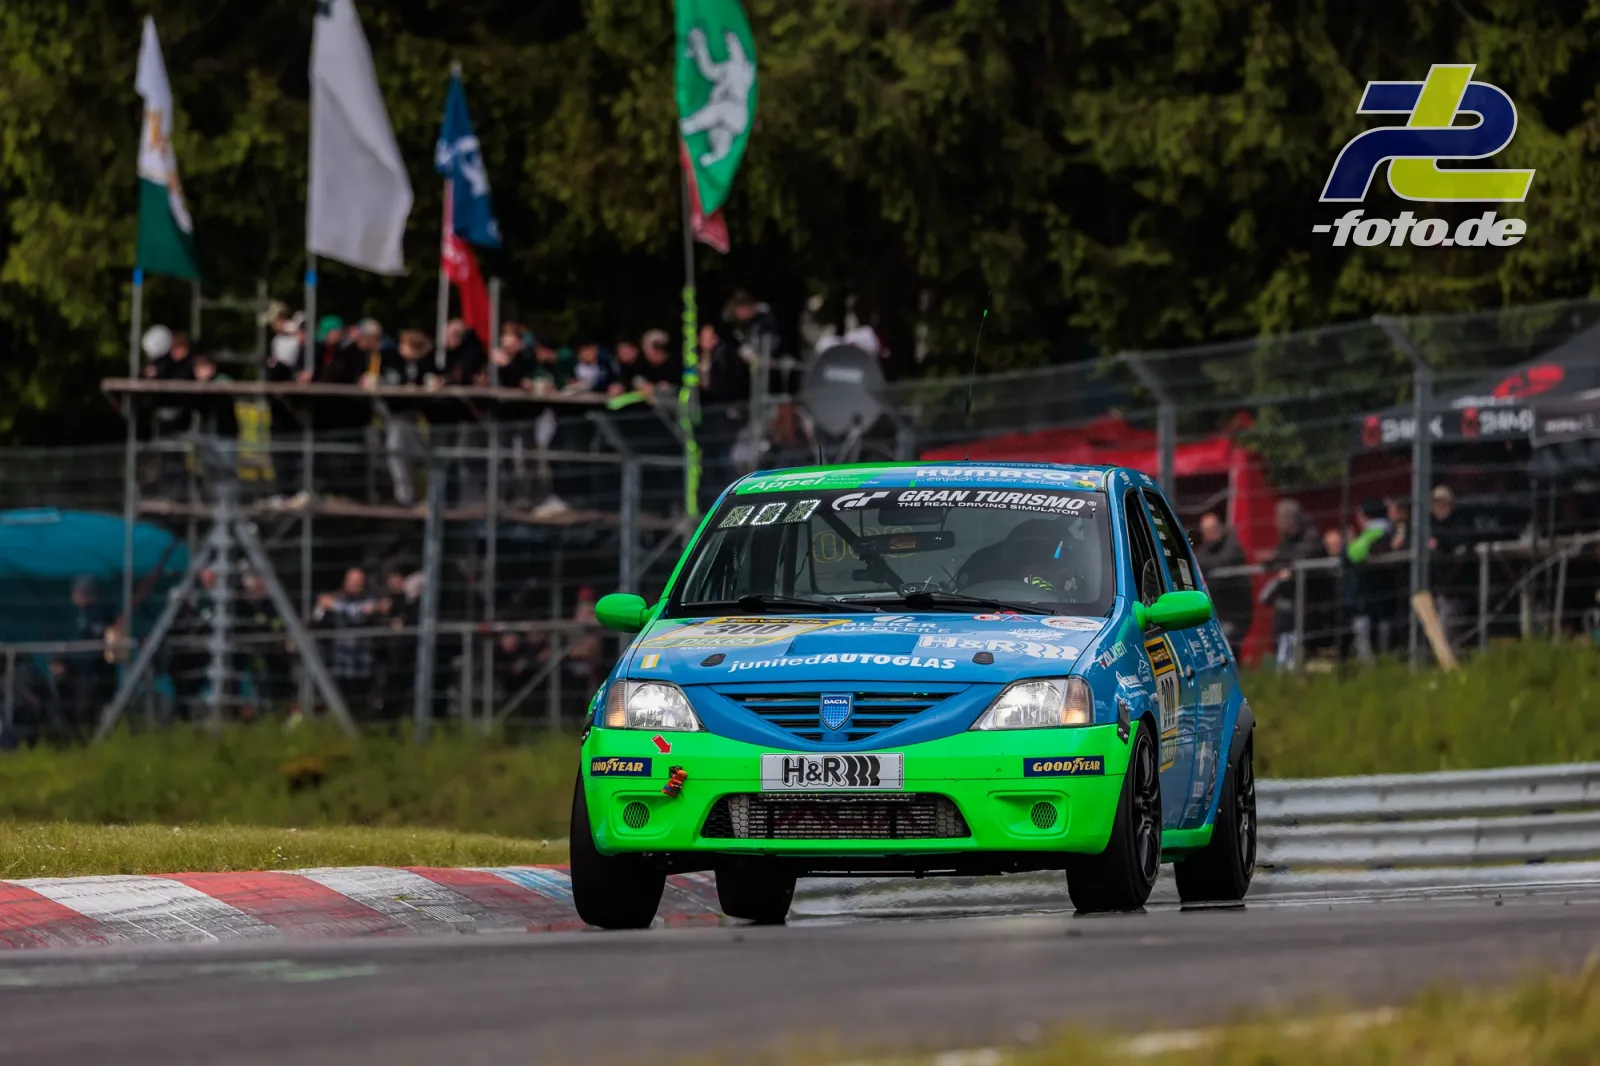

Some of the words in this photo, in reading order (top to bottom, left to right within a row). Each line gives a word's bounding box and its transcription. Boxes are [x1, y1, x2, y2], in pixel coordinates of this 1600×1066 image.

[747, 476, 826, 491] Appel
[897, 490, 974, 502] GRAN
[1010, 504, 1079, 516] SIMULATOR
[704, 624, 789, 635] 300
[678, 637, 756, 645] DEKRA
[919, 634, 1026, 654] H&R
[728, 653, 956, 673] junitedAUTOGLAS
[783, 757, 846, 787] H&R
[1032, 758, 1100, 773] GOODYEAR
